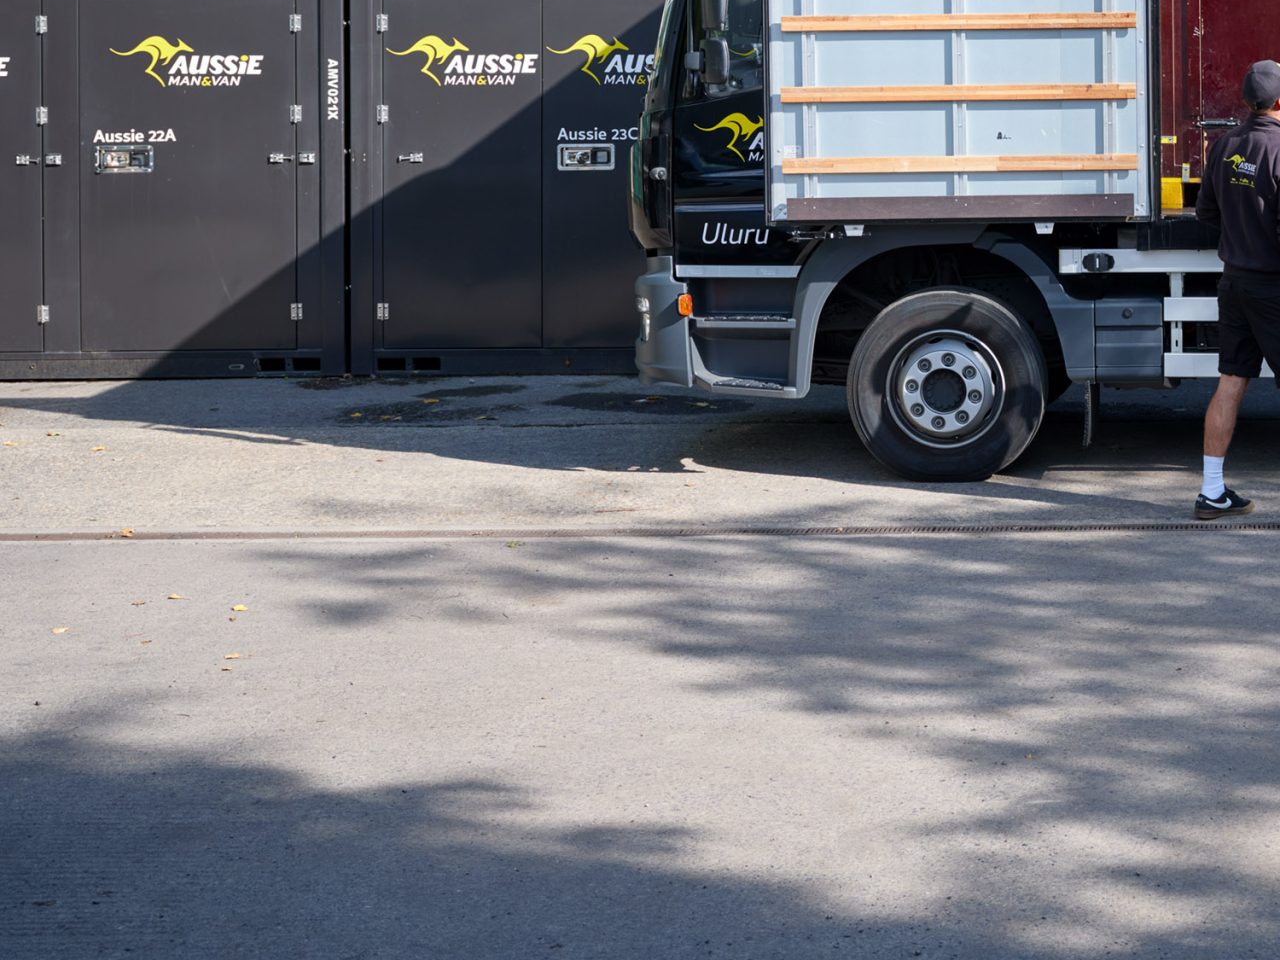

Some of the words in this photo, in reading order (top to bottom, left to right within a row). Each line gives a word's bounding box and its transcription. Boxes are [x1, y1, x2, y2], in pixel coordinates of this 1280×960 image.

[604, 53, 655, 74] AUS
[604, 74, 651, 85] MAN&
[327, 58, 339, 121] AMV021X
[93, 129, 145, 143] Aussie
[148, 129, 177, 142] 22A
[557, 127, 607, 140] Aussie
[611, 128, 639, 140] 23C
[702, 222, 770, 245] Uluru
